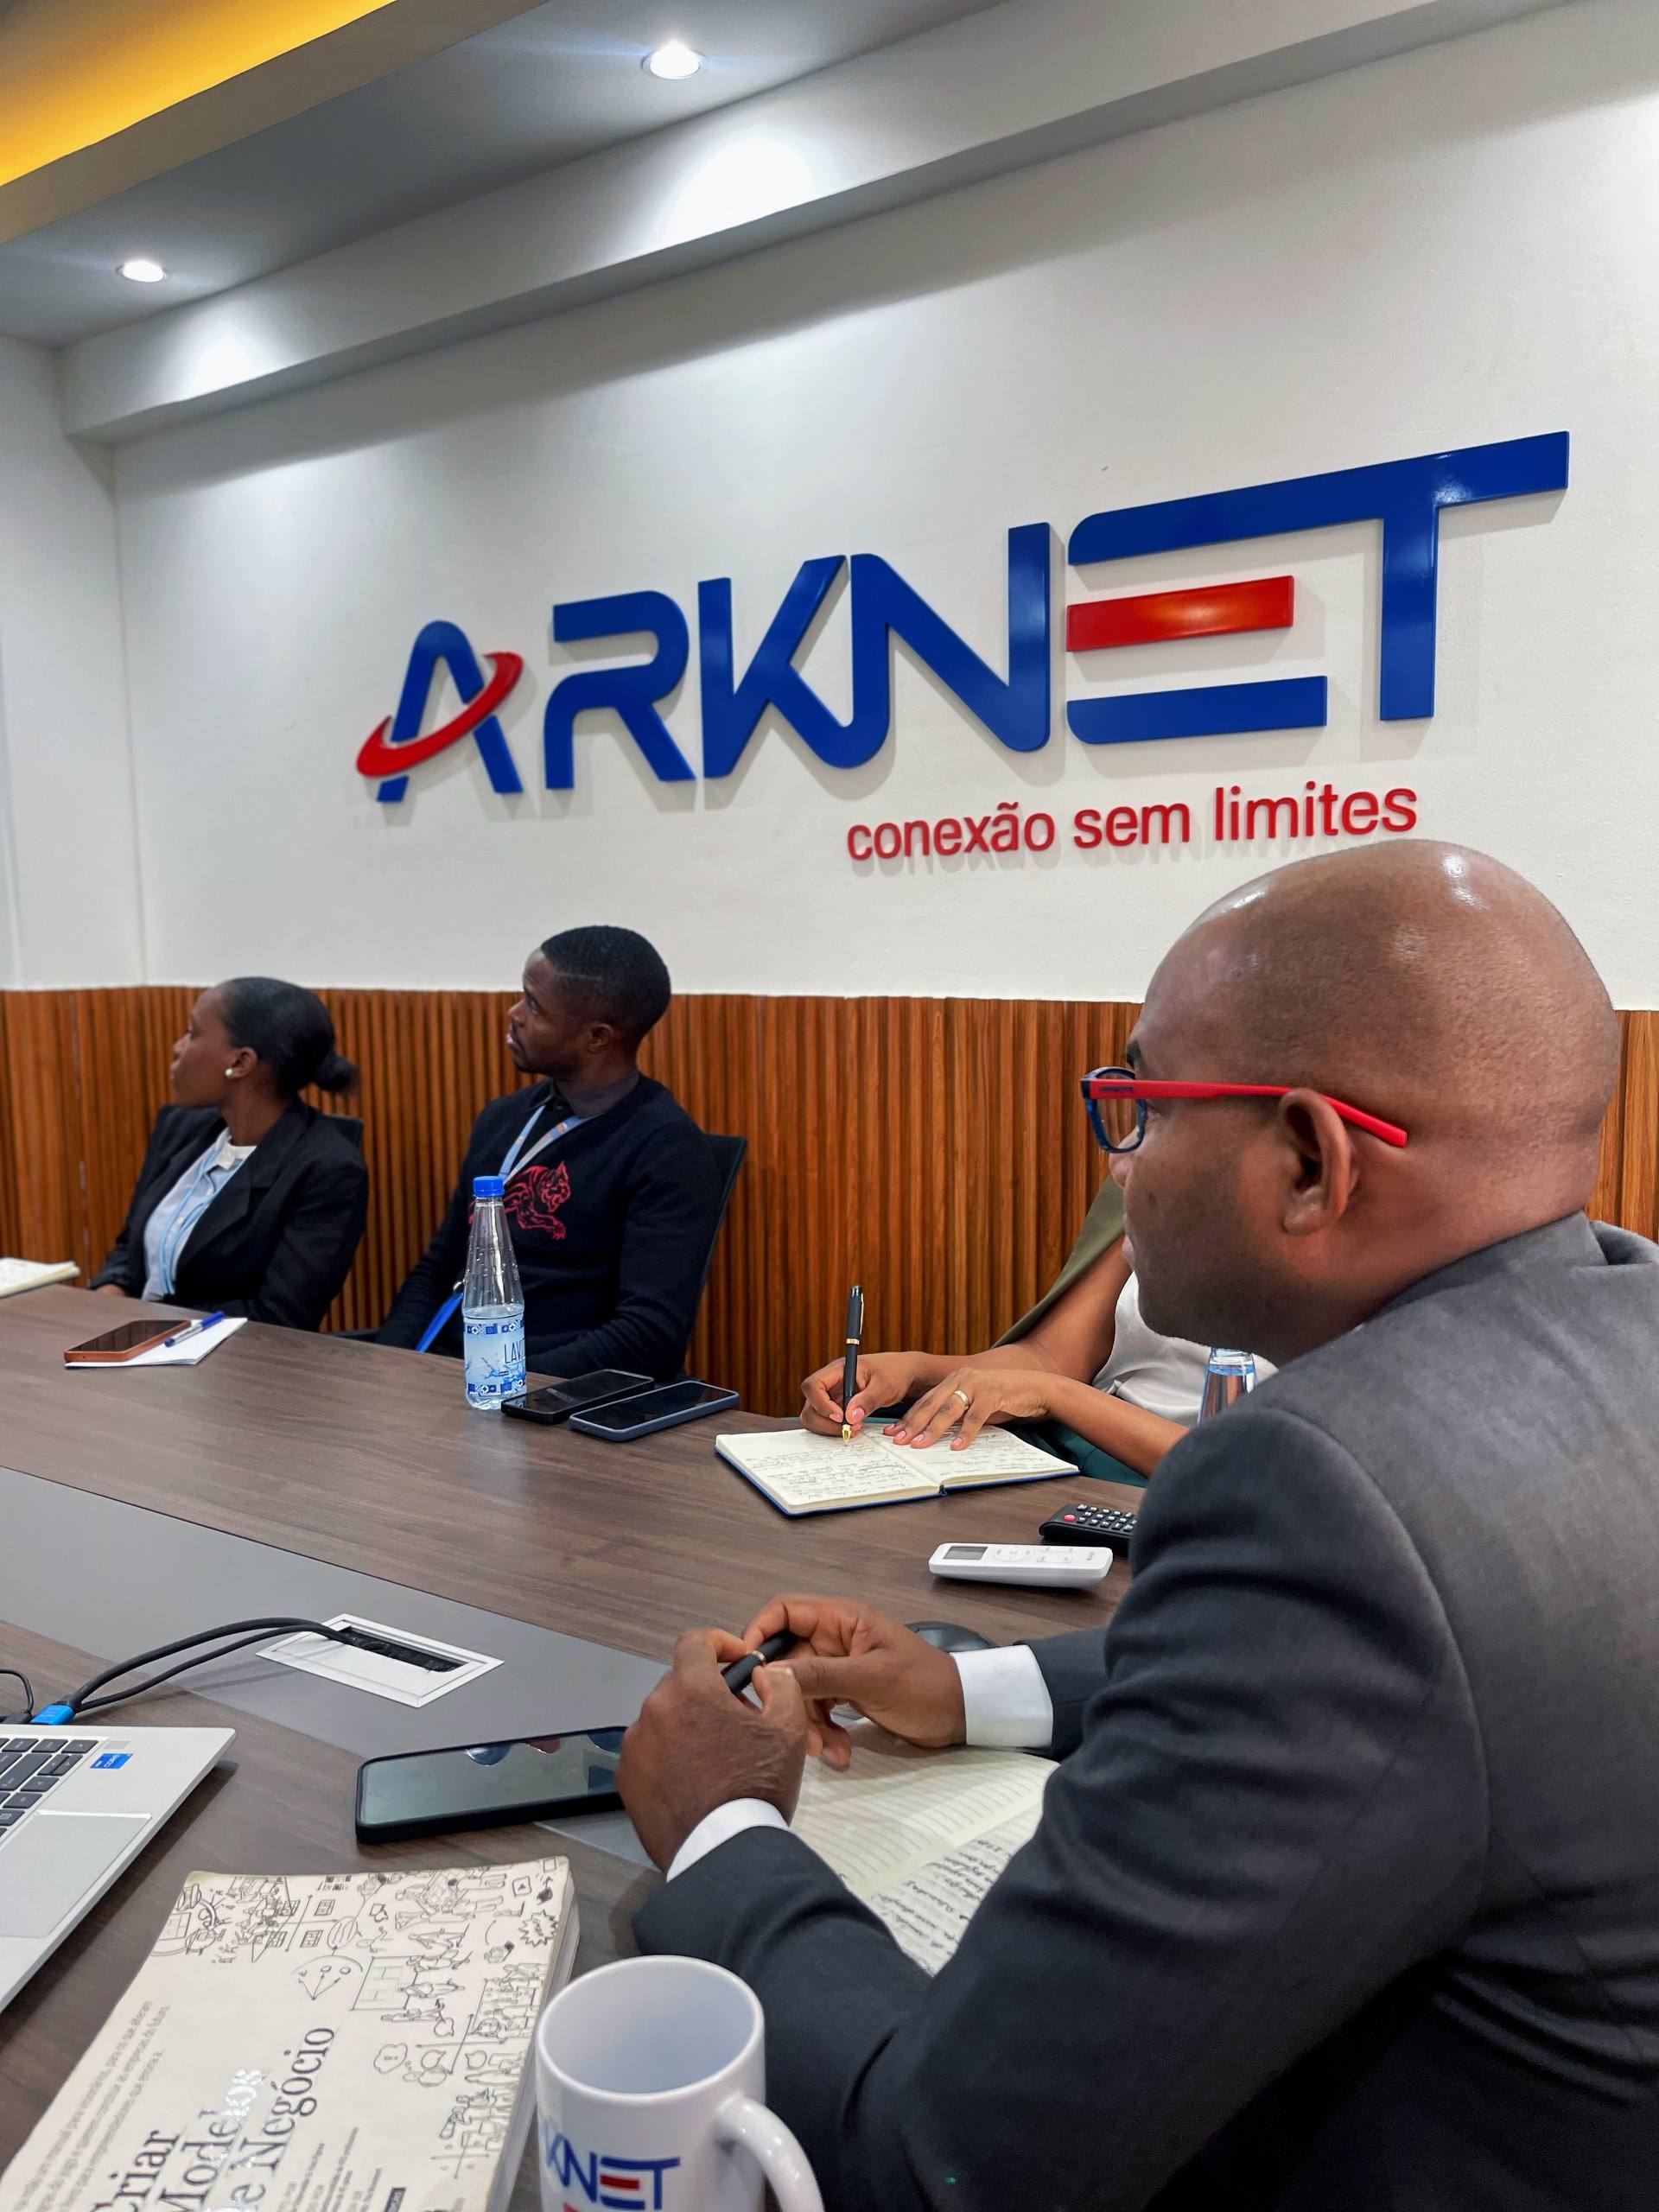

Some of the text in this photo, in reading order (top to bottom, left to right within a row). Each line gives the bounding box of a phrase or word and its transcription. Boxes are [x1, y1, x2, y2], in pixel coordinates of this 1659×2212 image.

[356, 431, 1569, 803] ARKNET
[847, 780, 1417, 861] conexão sem limites
[229, 2027, 335, 2173] Negócio
